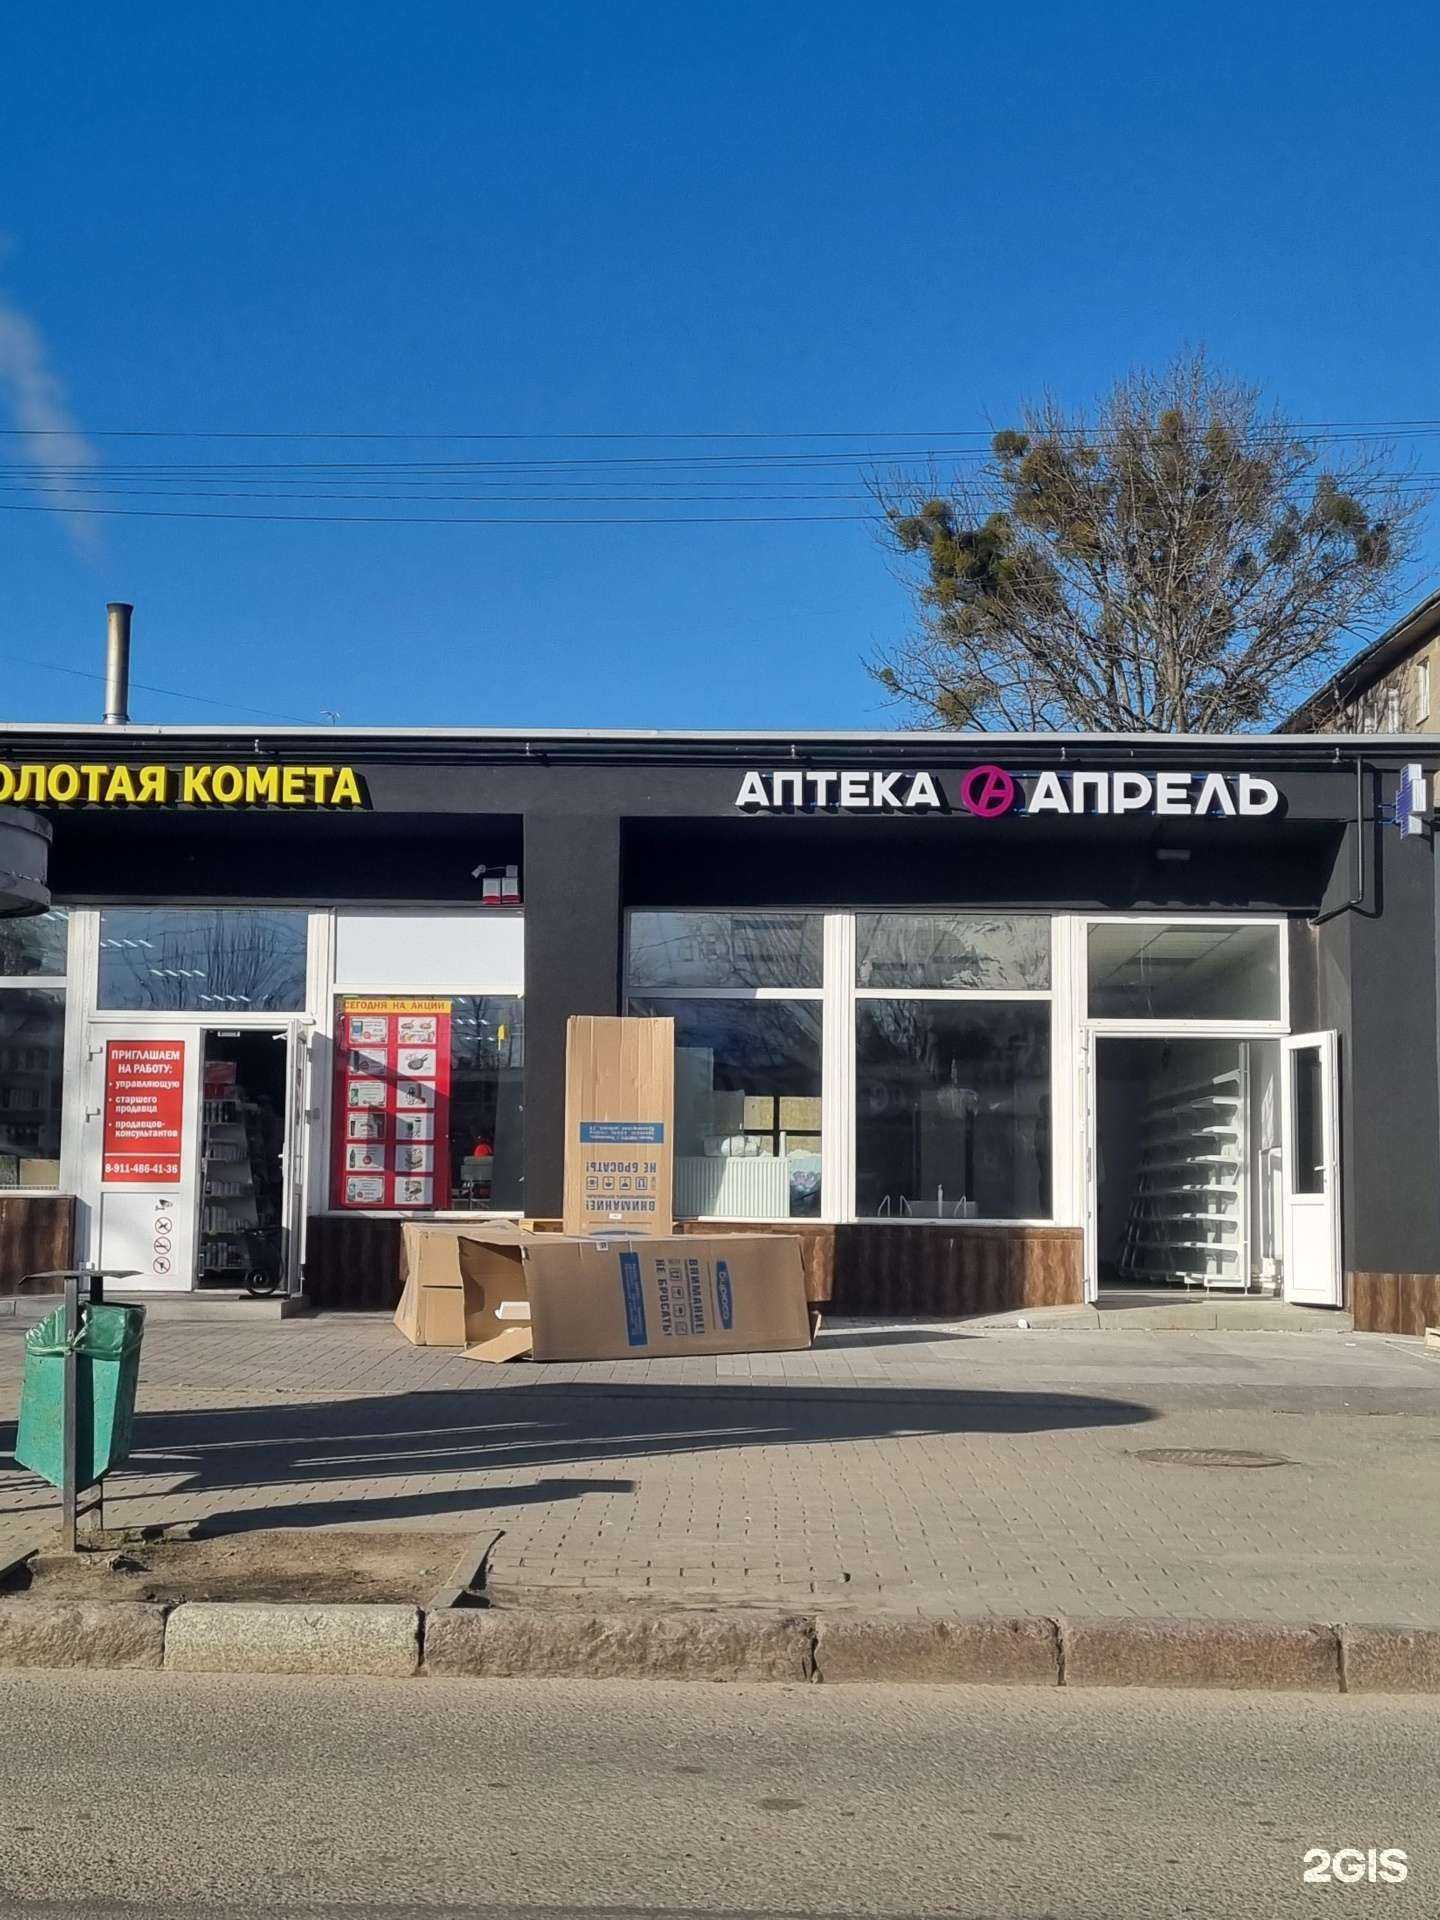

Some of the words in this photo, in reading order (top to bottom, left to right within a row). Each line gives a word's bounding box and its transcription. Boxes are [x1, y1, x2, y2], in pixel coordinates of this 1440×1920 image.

[183, 766, 361, 804] КОМЕТА
[735, 771, 940, 806] АПТЕКА
[1028, 771, 1279, 815] АПРЕЛЬ
[345, 1001, 387, 1010] СЕГОДНЯ
[393, 1001, 405, 1010] НА
[412, 1001, 445, 1010] АКЦИИ
[111, 1050, 180, 1060] ПРИГЛАШАЕМ
[118, 1064, 132, 1074] НА
[134, 1064, 173, 1074] РАБОТУ:
[115, 1080, 180, 1089] управляющую
[115, 1096, 158, 1105] старшего
[115, 1105, 158, 1114] продавца
[115, 1130, 178, 1139] консультантов
[586, 1161, 638, 1173] БРОСАТЬ!
[644, 1162, 657, 1173] НЕ
[586, 1200, 656, 1212] ВНИМАНИЕ!
[655, 1259, 666, 1273] НЕ
[688, 1259, 705, 1334] ВНИМАНИЕ!
[657, 1279, 673, 1336] БРОСАТЬ!
